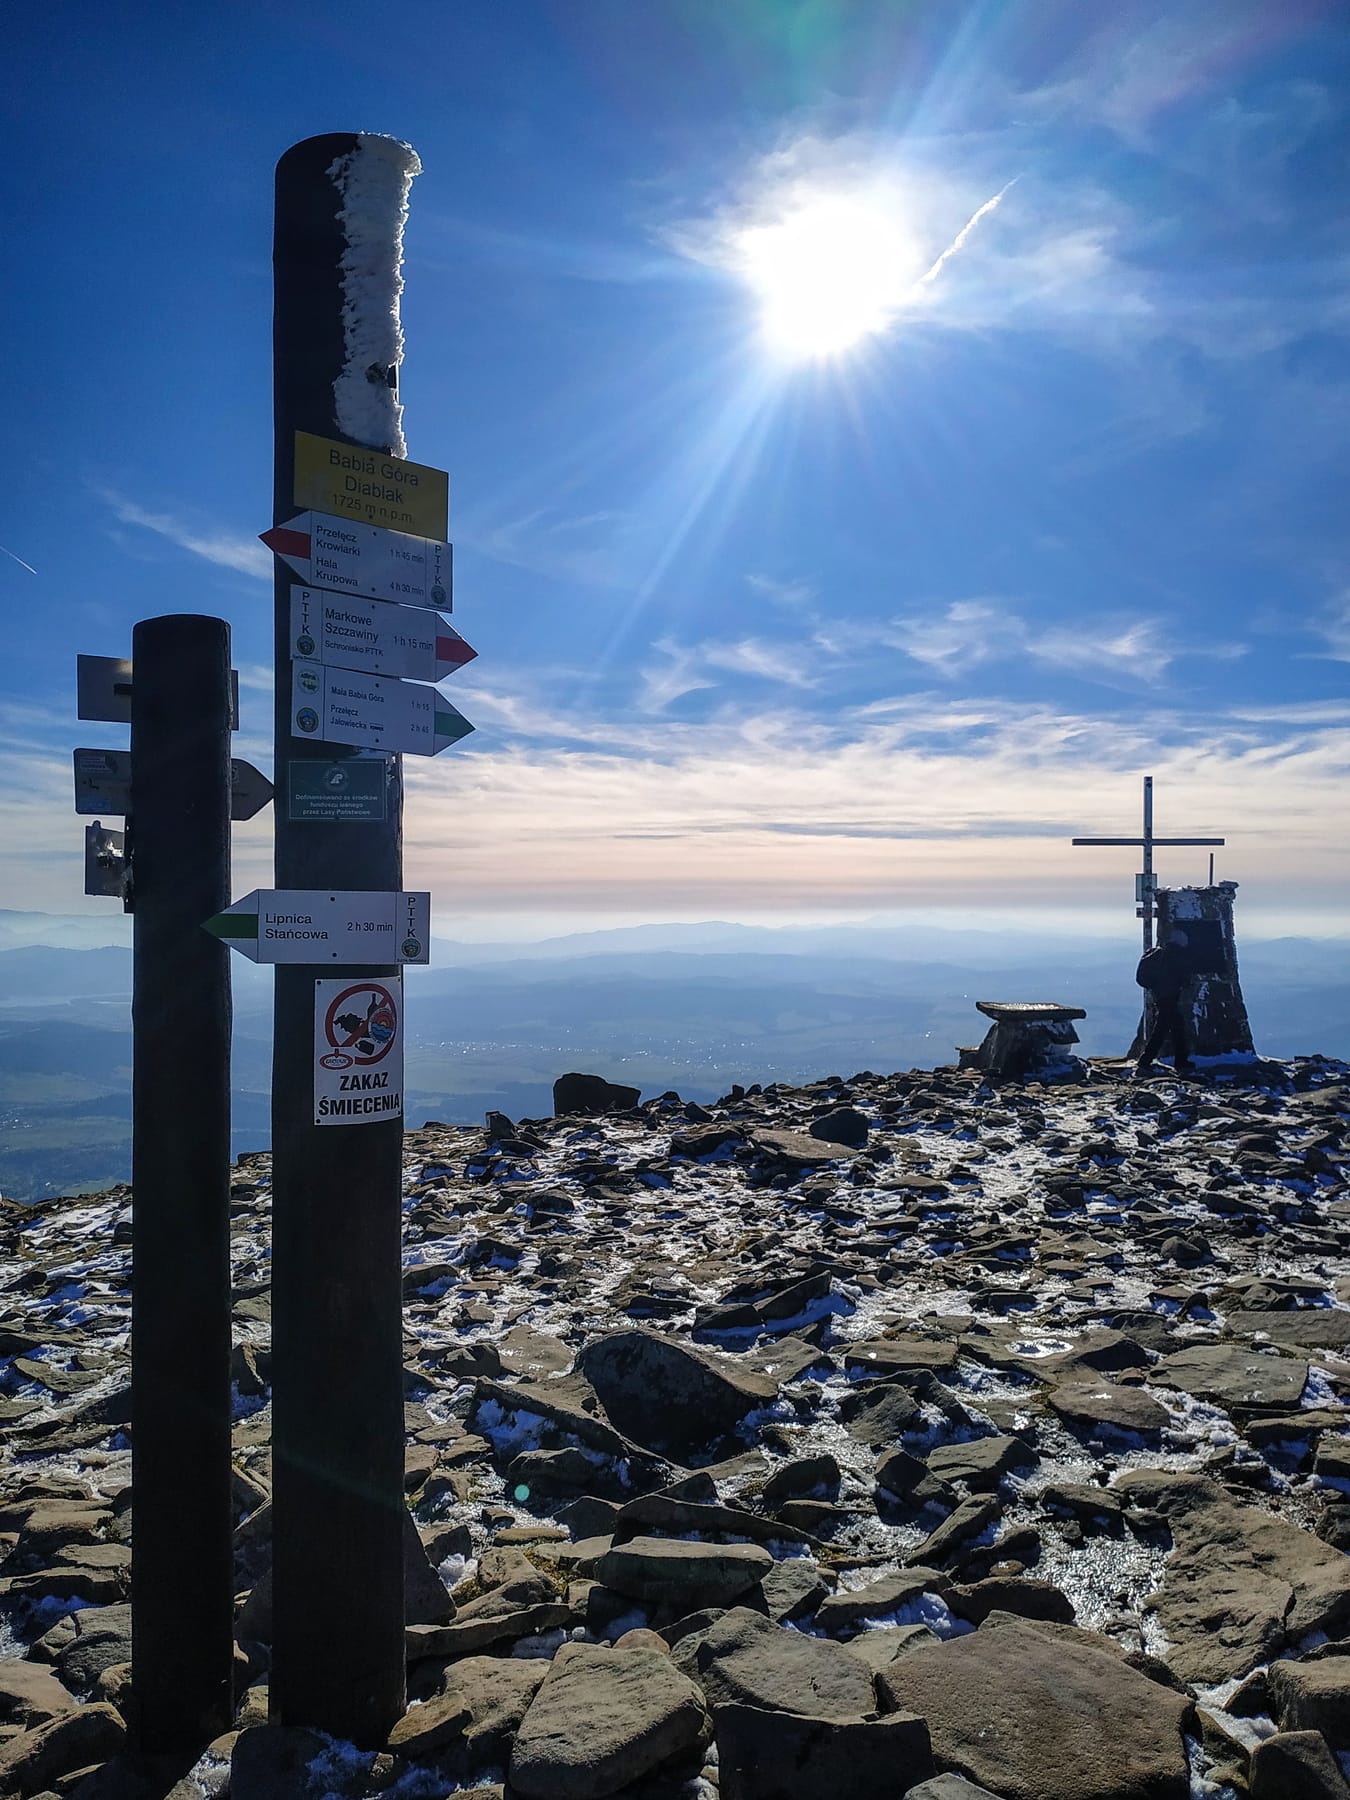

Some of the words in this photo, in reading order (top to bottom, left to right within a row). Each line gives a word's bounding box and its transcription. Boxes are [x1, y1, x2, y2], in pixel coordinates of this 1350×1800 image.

[329, 449, 375, 474] Babia
[380, 463, 419, 487] Góra
[345, 475, 404, 504] Diablak
[333, 494, 362, 511] 1725
[365, 503, 376, 515] m
[379, 506, 415, 525] n.p.m.
[316, 525, 357, 543] Przełęcz
[316, 538, 361, 556] Krowiarki
[316, 556, 338, 570] Hala
[434, 544, 442, 585] PTTK
[316, 569, 358, 587] Krupowa
[401, 583, 410, 592] 30
[302, 592, 310, 634] PTTK
[325, 608, 372, 625] Markowe
[325, 622, 379, 644] Szczawiny
[400, 636, 406, 646] h
[408, 638, 417, 649] 15
[419, 639, 433, 650] min
[265, 913, 312, 926] Lipnica
[407, 897, 416, 938] PTTK
[265, 928, 328, 940] Stańcowa
[347, 922, 352, 931] 2
[355, 922, 361, 931] h
[363, 922, 375, 932] 30
[376, 922, 393, 932] min
[339, 1072, 389, 1092] ZAKAZ
[318, 1094, 400, 1116] ŚMIECENIA
